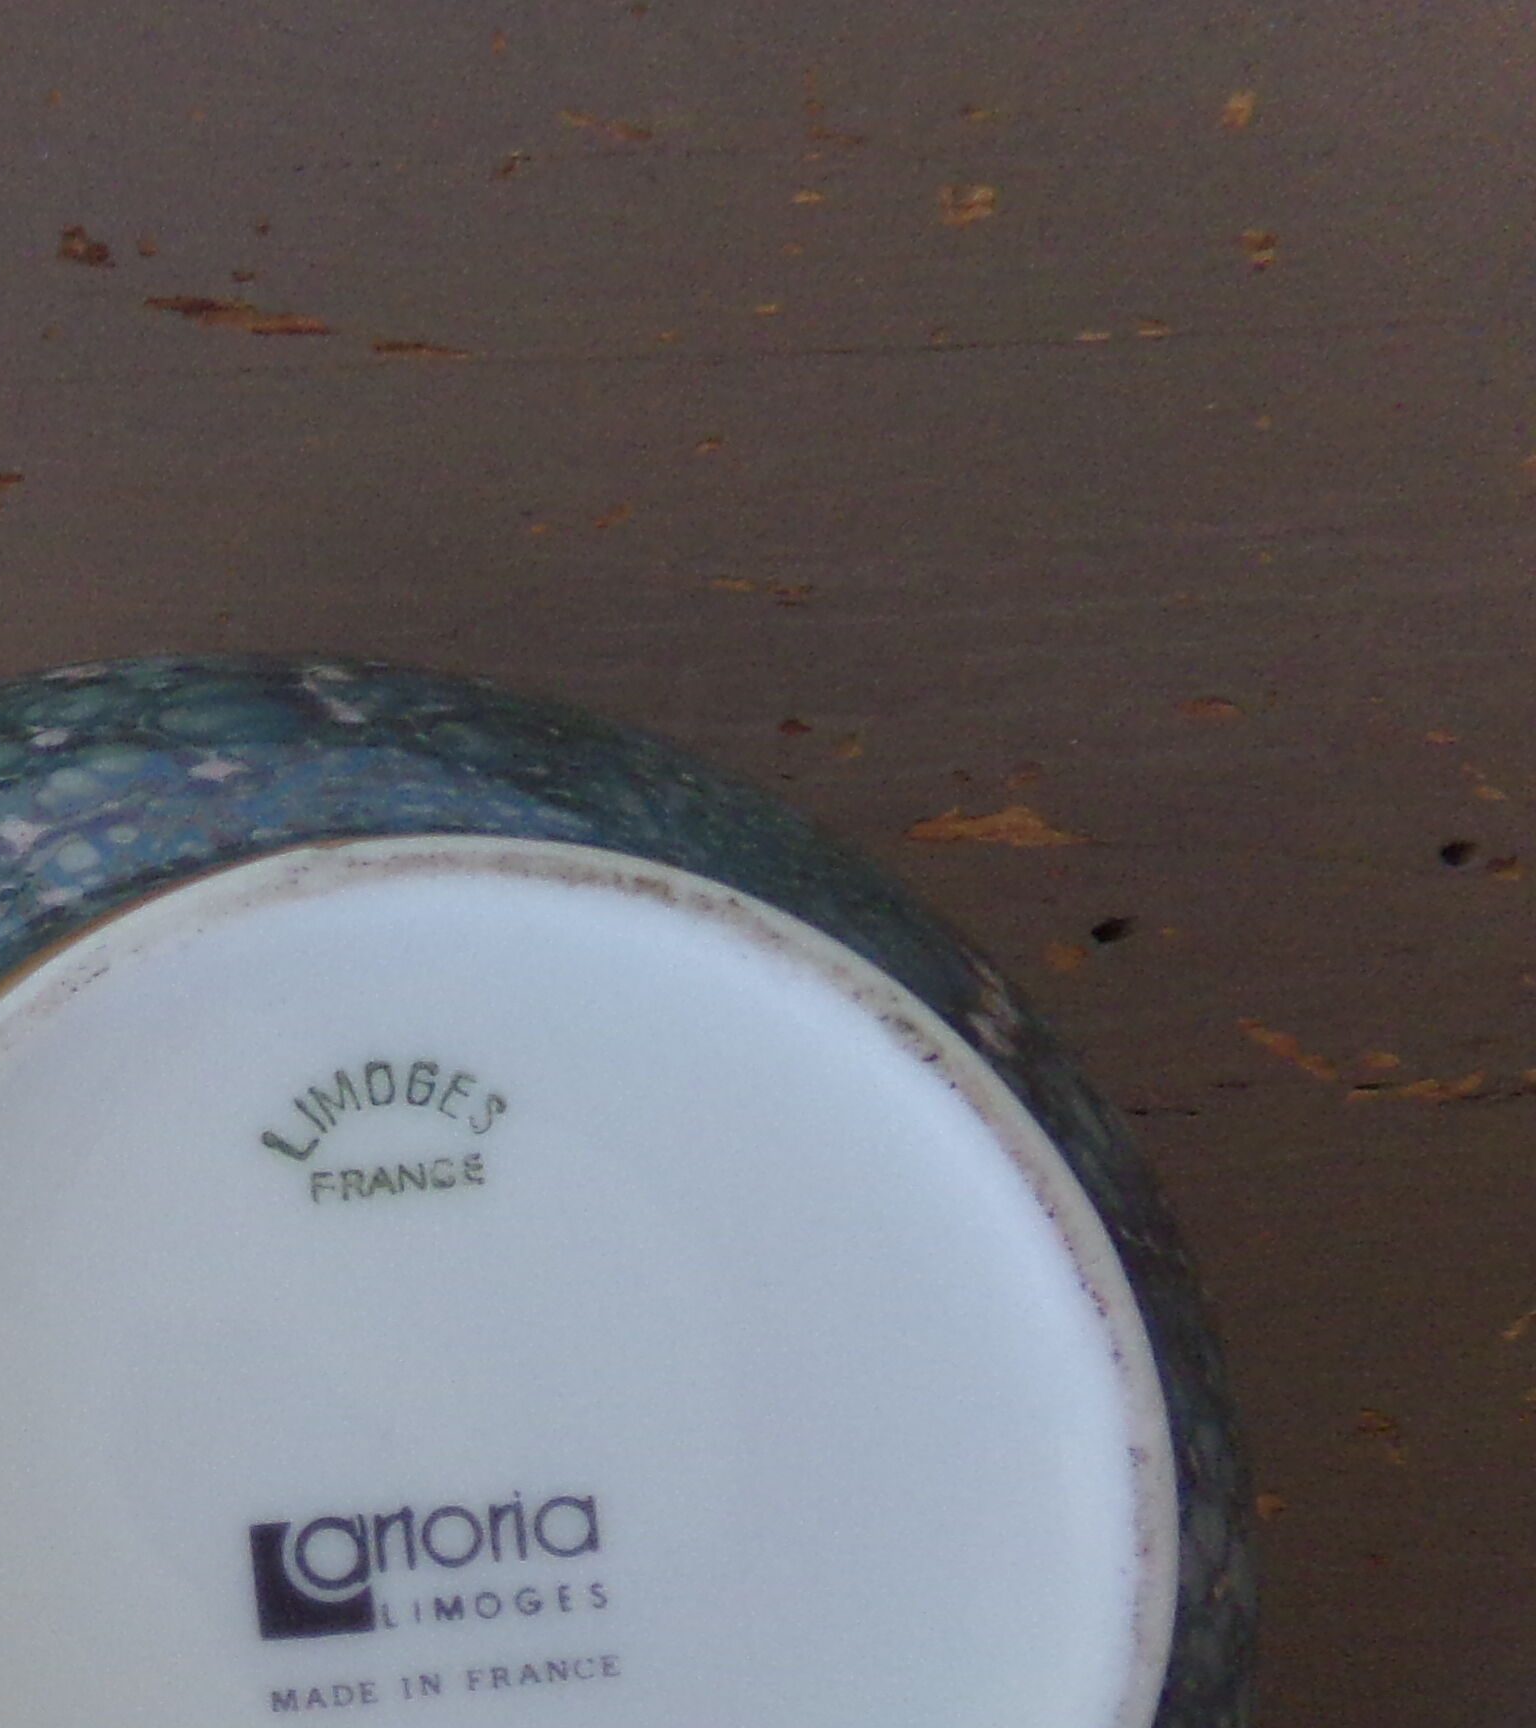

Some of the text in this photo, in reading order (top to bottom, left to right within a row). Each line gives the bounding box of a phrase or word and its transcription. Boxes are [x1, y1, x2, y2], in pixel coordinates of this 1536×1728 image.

[260, 1059, 508, 1161] LIMOGES
[310, 1152, 485, 1202] FRANCE
[380, 1582, 608, 1629] LIMOGES
[269, 1655, 621, 1712] MADE IN FRANCE
